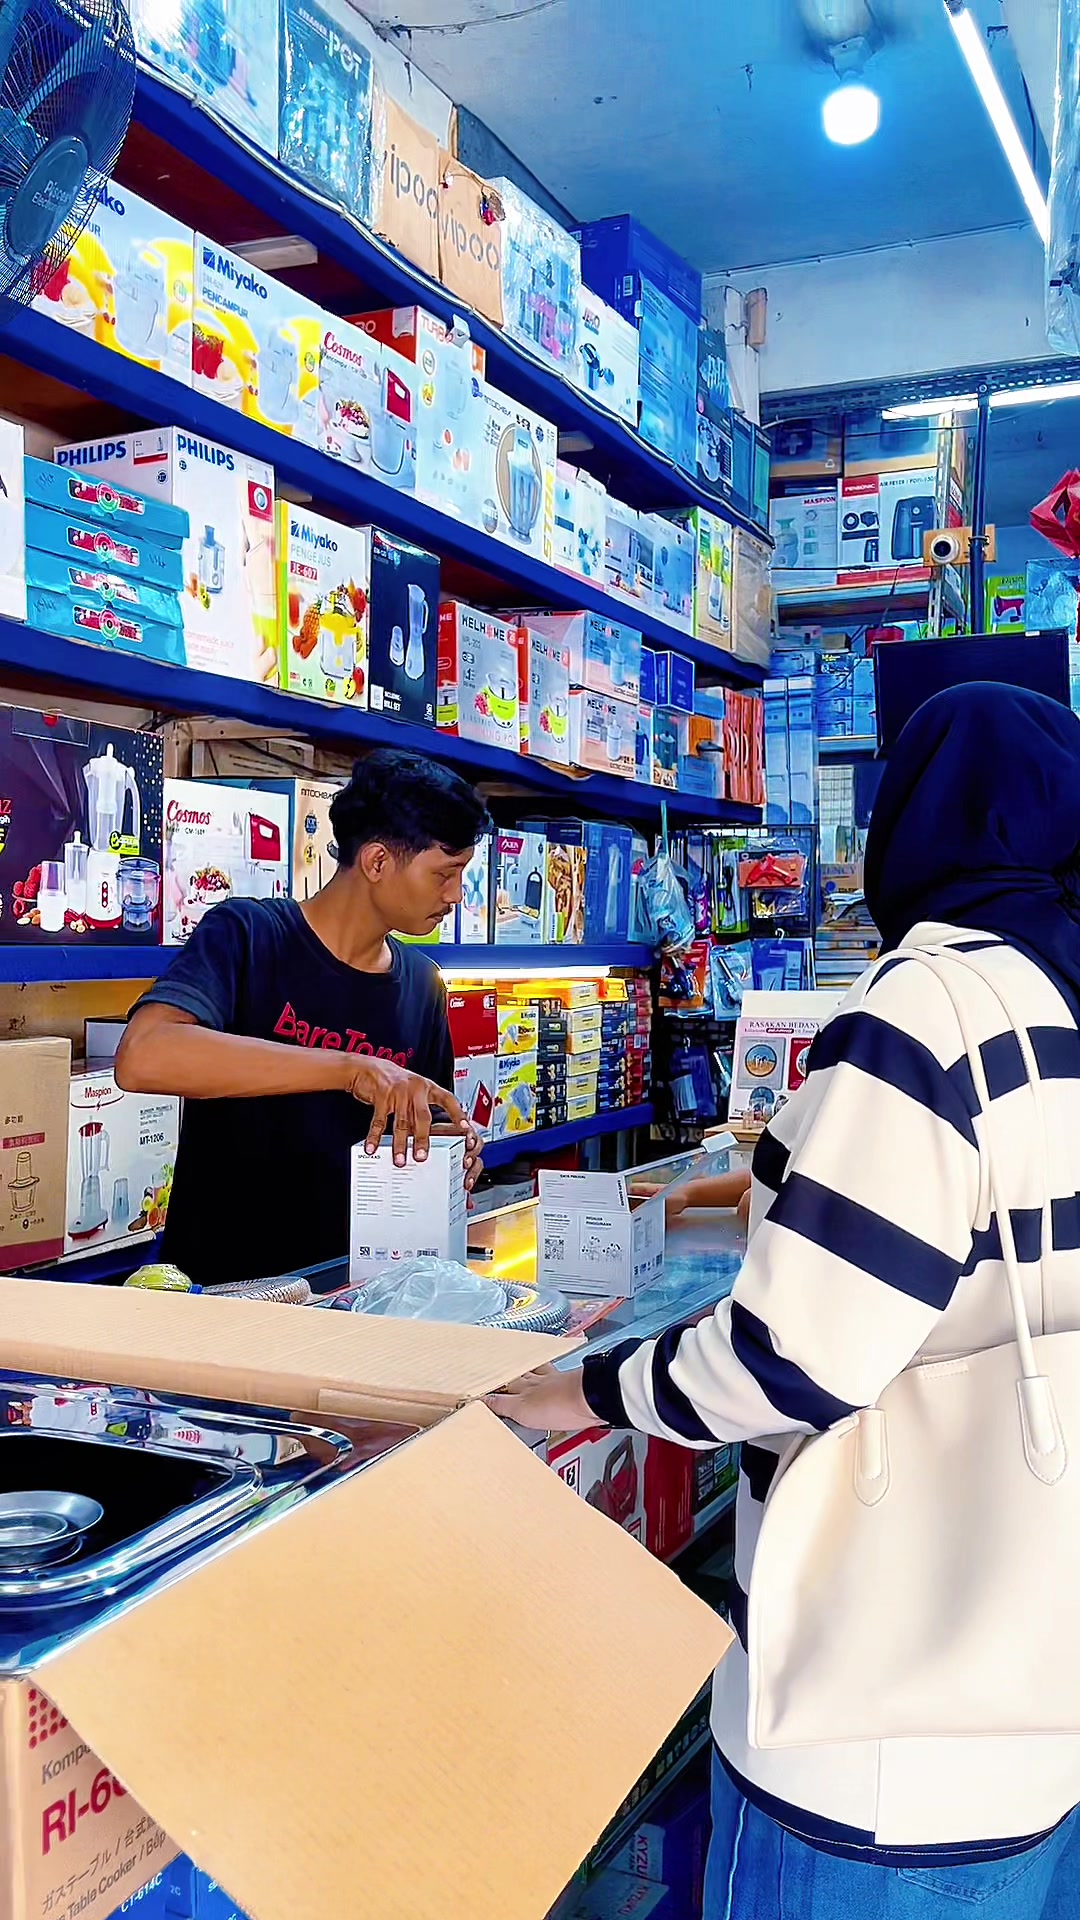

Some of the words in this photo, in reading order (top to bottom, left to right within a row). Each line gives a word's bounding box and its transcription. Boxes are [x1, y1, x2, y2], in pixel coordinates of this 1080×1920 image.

[329, 30, 363, 80] POT
[383, 144, 439, 217] ipoo
[217, 255, 268, 300] Miyako
[202, 287, 249, 319] PENCAMPUR
[324, 331, 364, 367] Cosmos
[57, 441, 126, 466] PHILIPS
[177, 433, 235, 471] PHILIPS
[803, 496, 836, 505] MASPION
[301, 524, 338, 552] Miyako
[291, 544, 332, 568] PENGEJUS
[291, 562, 317, 580] JE-607
[166, 799, 212, 825] Cosmos
[788, 1021, 820, 1029] BEDANY
[84, 1086, 112, 1099] Maspion
[139, 1132, 164, 1145] MT-1206
[43, 1850, 112, 1915] ガステーブル
[67, 1888, 97, 1919] Table
[98, 1855, 137, 1894] Cooker
[121, 1872, 163, 1913] CT-614C
